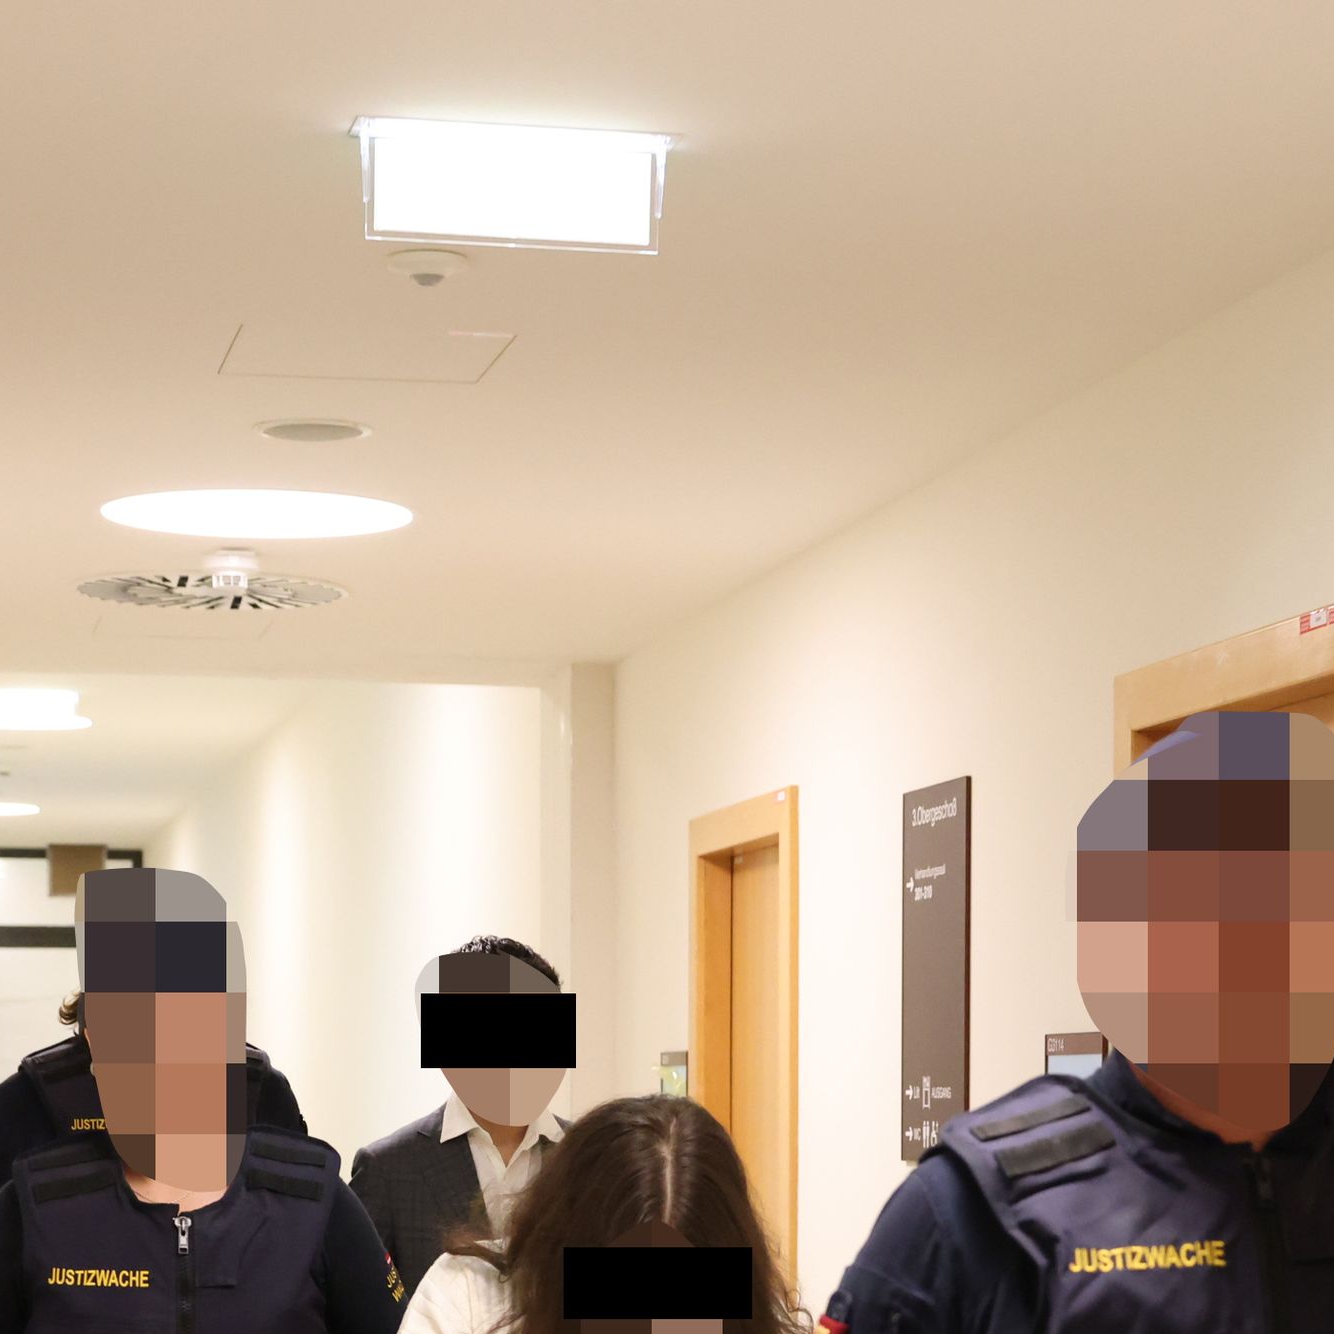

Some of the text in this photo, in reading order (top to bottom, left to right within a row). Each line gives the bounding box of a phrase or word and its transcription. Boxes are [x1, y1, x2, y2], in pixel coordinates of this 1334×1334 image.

[71, 1118, 106, 1131] JUSTIZ
[1069, 1240, 1227, 1272] JUSTIZWACHE
[48, 1267, 150, 1288] JUSTIZWACHE
